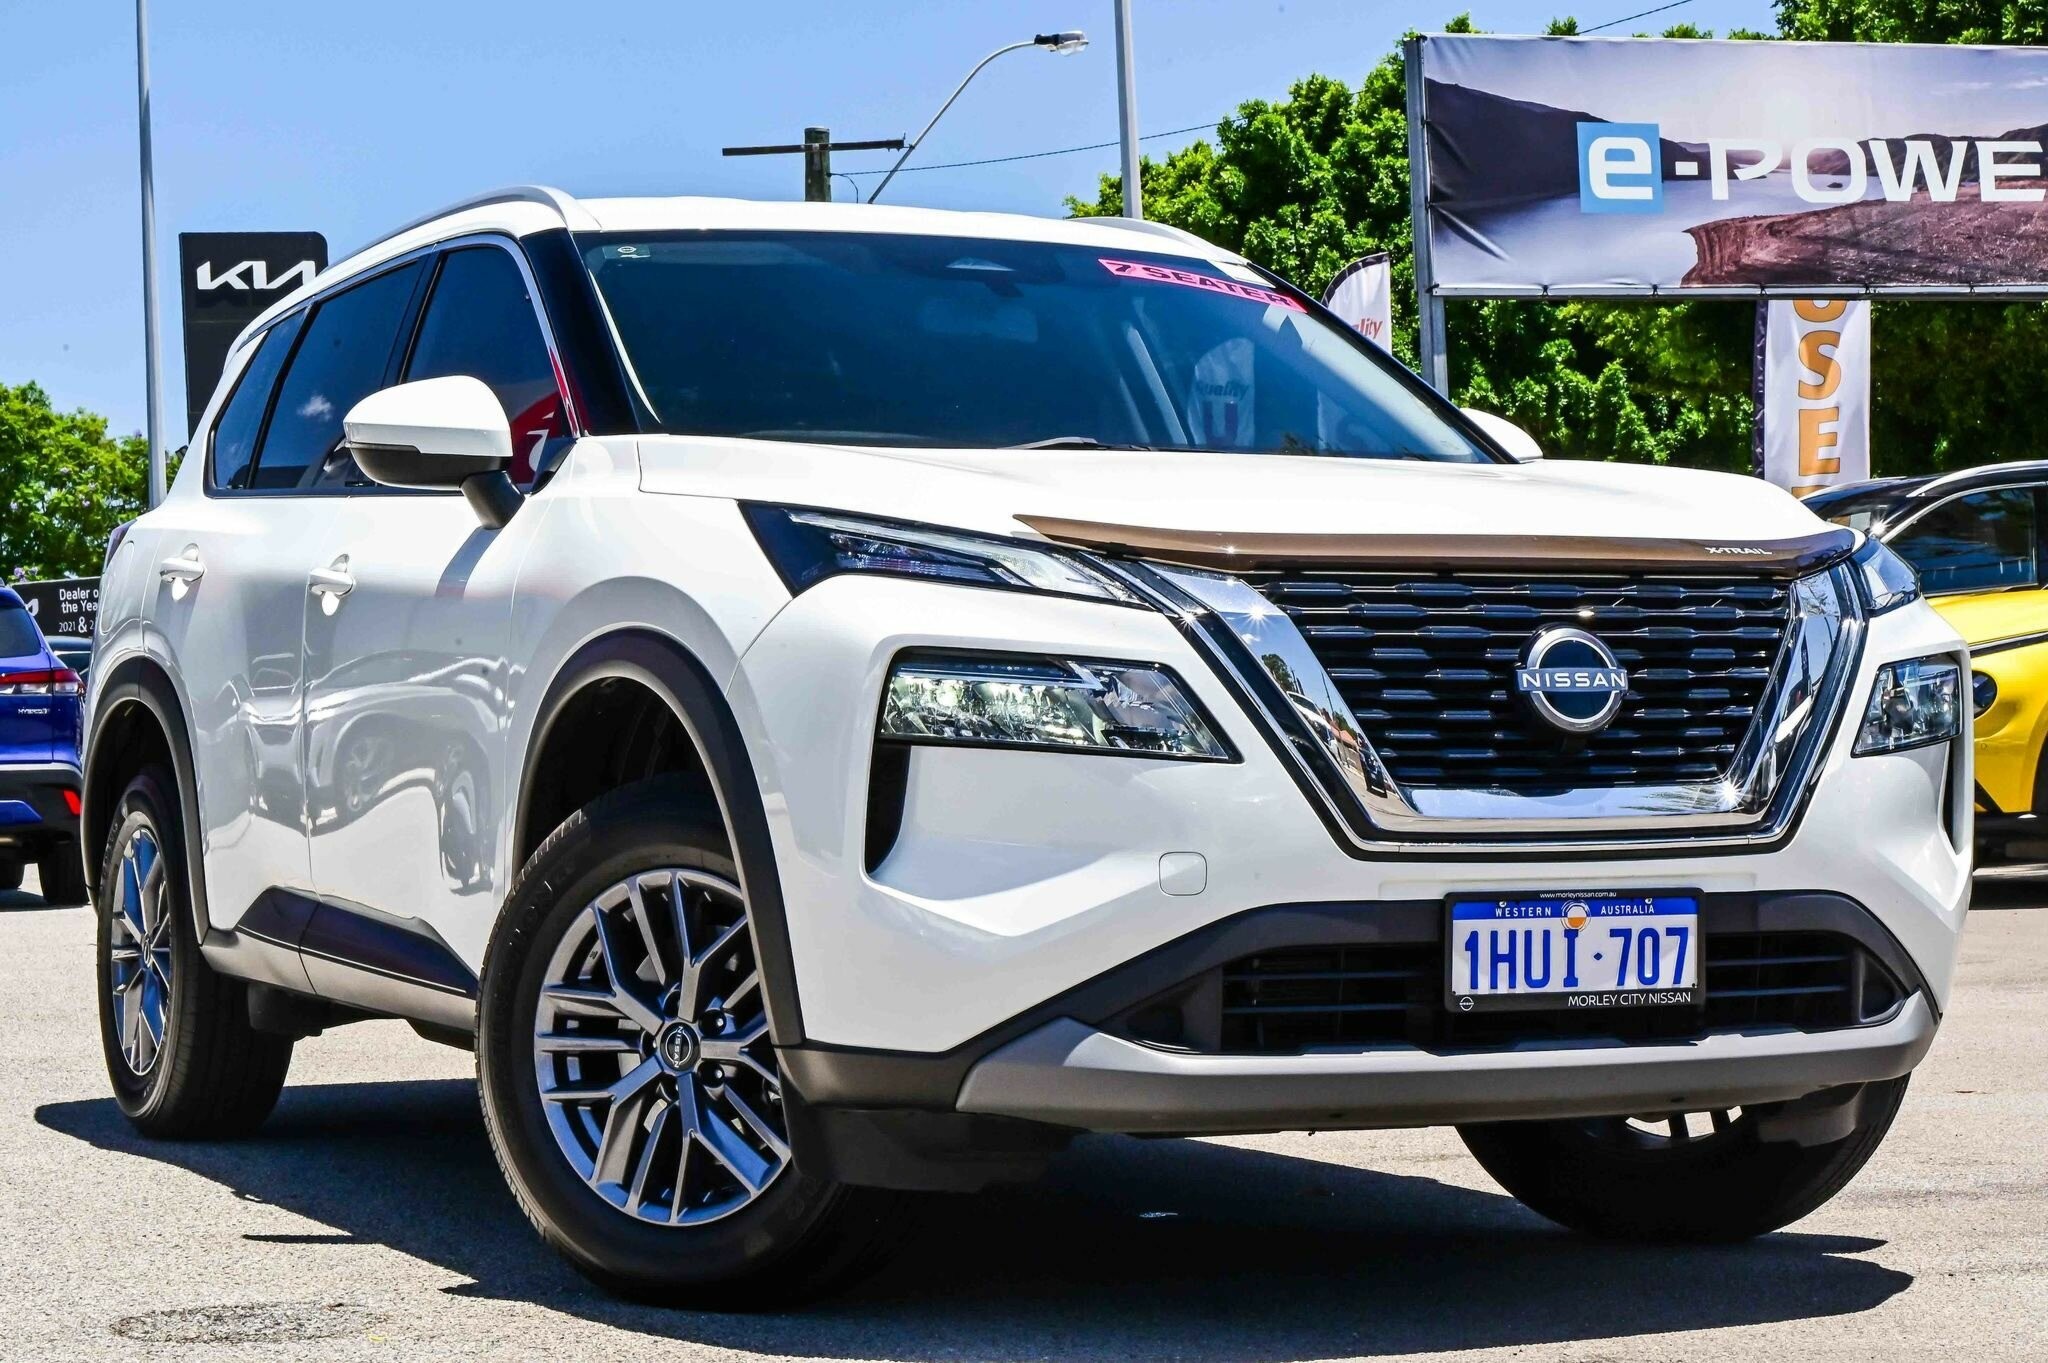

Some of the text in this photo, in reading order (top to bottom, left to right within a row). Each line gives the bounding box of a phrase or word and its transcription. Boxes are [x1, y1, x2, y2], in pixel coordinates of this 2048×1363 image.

[197, 260, 316, 290] KIA
[1106, 262, 1292, 307] 7 SEATER
[1705, 547, 1773, 555] X-TRAIL
[59, 587, 90, 601] Dealer
[61, 601, 78, 614] the
[58, 621, 76, 633] 2021
[78, 616, 87, 633] &
[1522, 672, 1626, 688] NISSAN
[1540, 891, 1617, 899] www.morleynissan.com.au
[1495, 904, 1655, 918] WESTERN AUSTRALIA
[1568, 992, 1691, 1007] MORLEY CITY NISSAN
